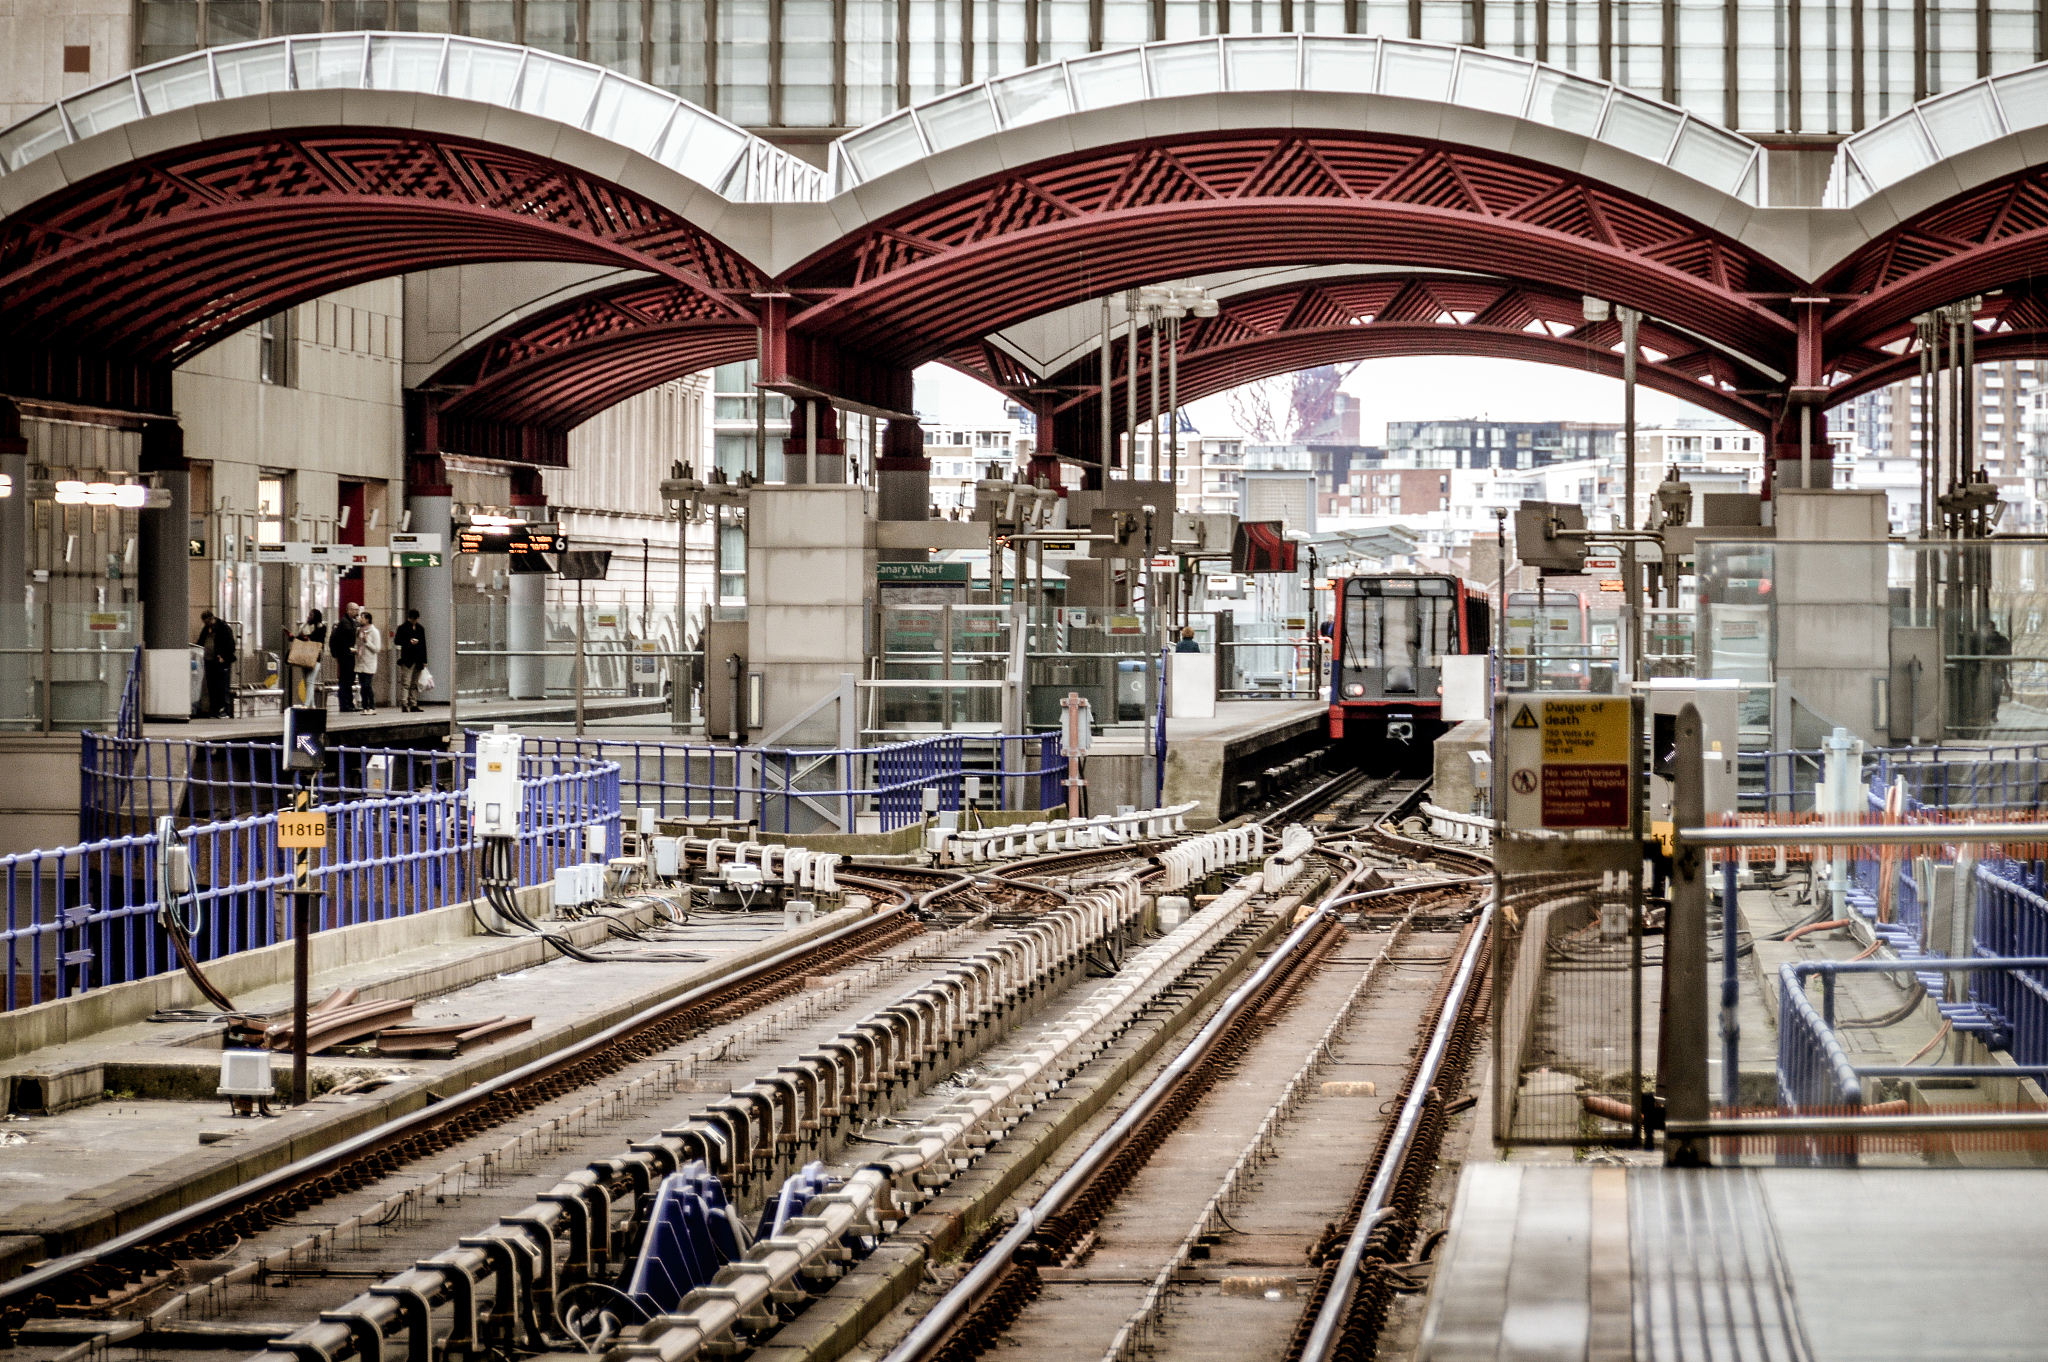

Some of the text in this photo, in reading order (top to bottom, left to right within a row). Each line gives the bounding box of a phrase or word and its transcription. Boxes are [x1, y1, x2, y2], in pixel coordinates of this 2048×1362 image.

[555, 537, 566, 551] 6
[910, 564, 944, 574] Wharf
[1545, 701, 1604, 715] Danger of
[1545, 714, 1580, 725] death
[1545, 729, 1560, 737] 750
[1562, 729, 1582, 737] Volts
[1565, 738, 1595, 747] Voltage
[1544, 768, 1622, 777] No unauthorised
[1544, 778, 1626, 789] personnel beyond
[1544, 788, 1563, 797] this
[279, 823, 325, 836] 1181B
